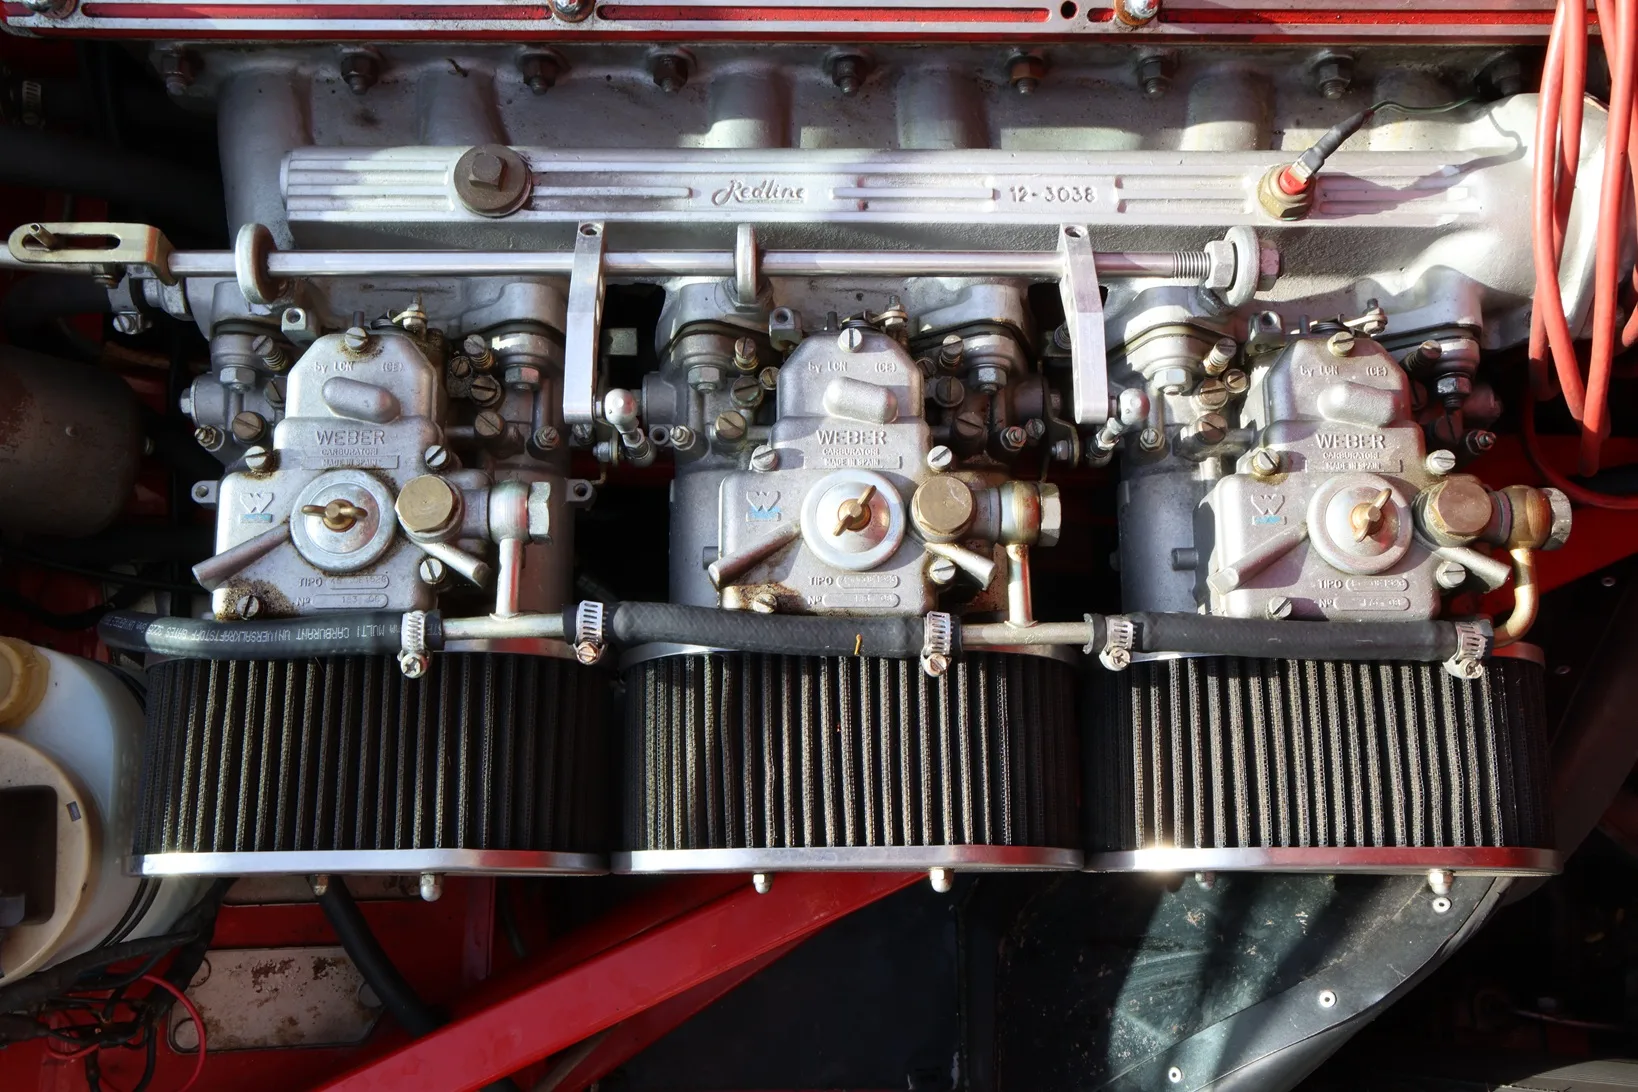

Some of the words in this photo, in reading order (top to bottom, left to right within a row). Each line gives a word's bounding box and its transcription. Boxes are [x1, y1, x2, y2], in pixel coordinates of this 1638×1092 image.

[711, 179, 805, 206] Redline
[1009, 185, 1096, 203] 12-3038
[316, 430, 386, 446] WEBER
[816, 430, 888, 446] WEBER
[1316, 433, 1387, 449] WEBER
[321, 448, 379, 456] CARBURATORI
[822, 448, 881, 457] CARBURATORI
[1323, 452, 1381, 460] CARBURATORI
[356, 458, 379, 467] SPAIN
[858, 458, 881, 467] SPAIN
[1359, 462, 1382, 470] SPAIN
[299, 577, 323, 588] TIPO
[808, 576, 834, 586] TIPO
[1318, 579, 1344, 589] TIPO
[165, 626, 188, 640] GATES
[190, 627, 291, 643] UNIVERSALKRAFTSTOFF
[296, 626, 350, 641] CARBURANT
[356, 624, 385, 638] MULTI
